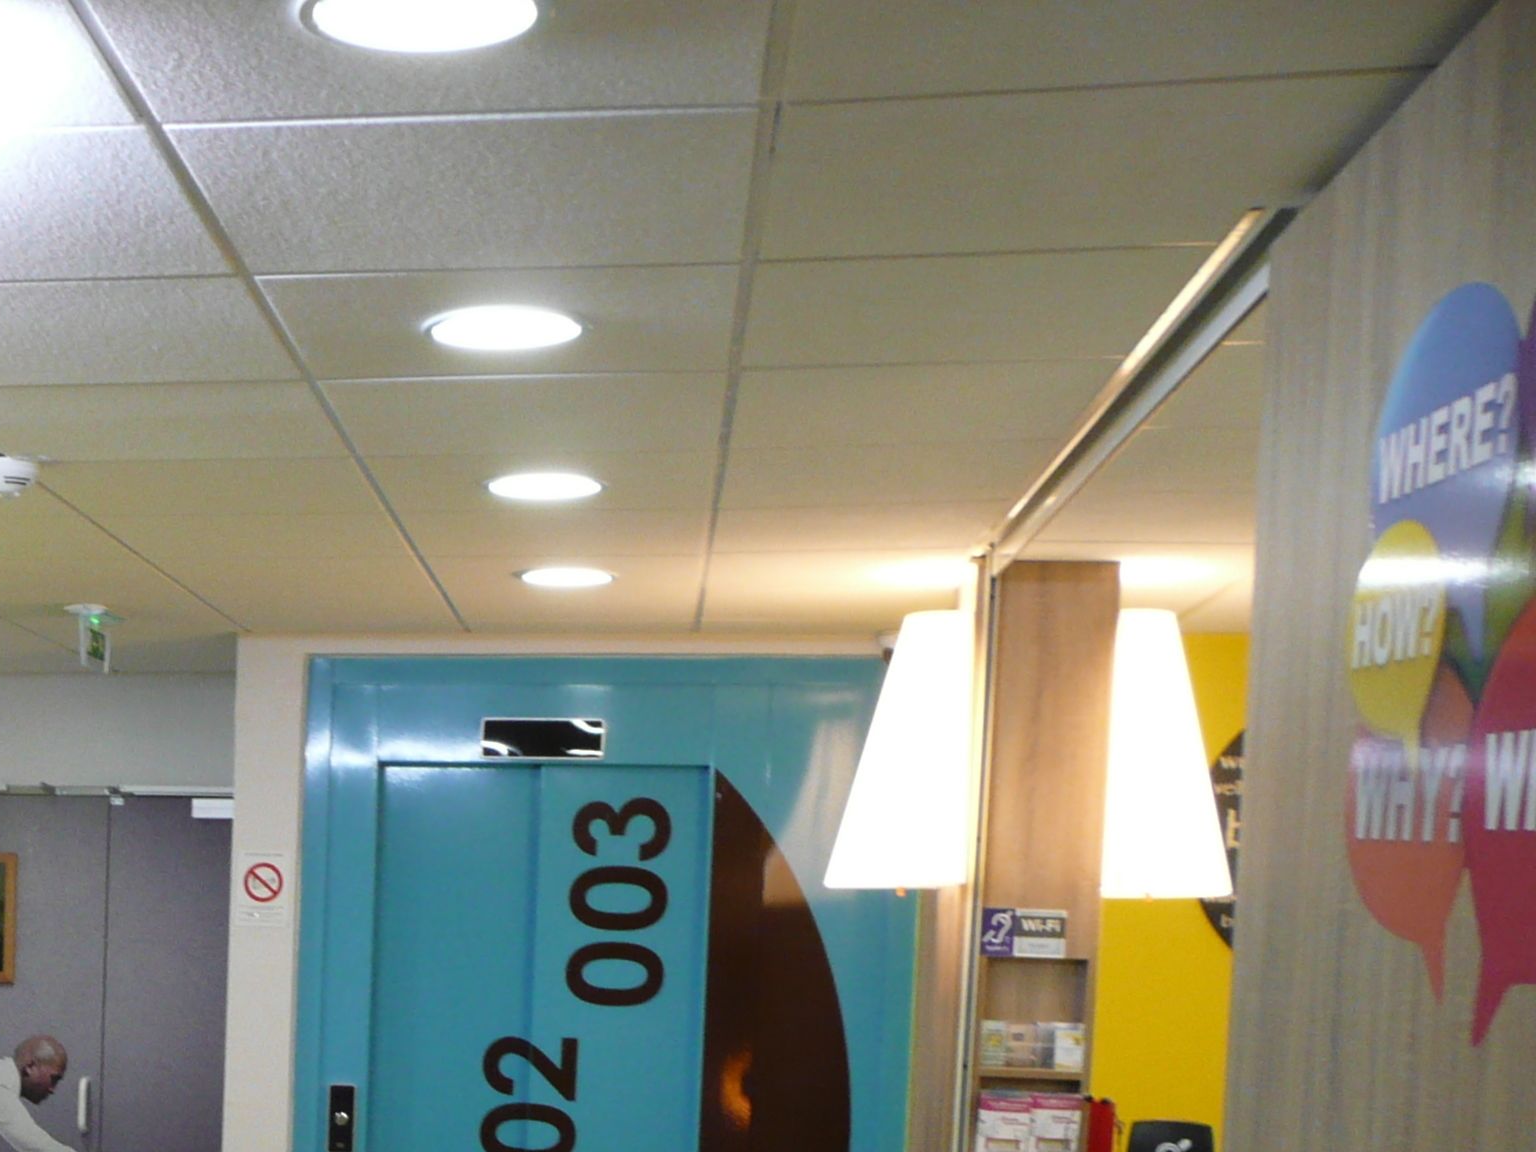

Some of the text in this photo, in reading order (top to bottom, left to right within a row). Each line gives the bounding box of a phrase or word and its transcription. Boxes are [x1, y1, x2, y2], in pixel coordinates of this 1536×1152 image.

[1378, 372, 1520, 504] WHERE?
[1351, 586, 1442, 669] HOW?
[1352, 743, 1467, 843] WHY?
[565, 796, 672, 1007] 003
